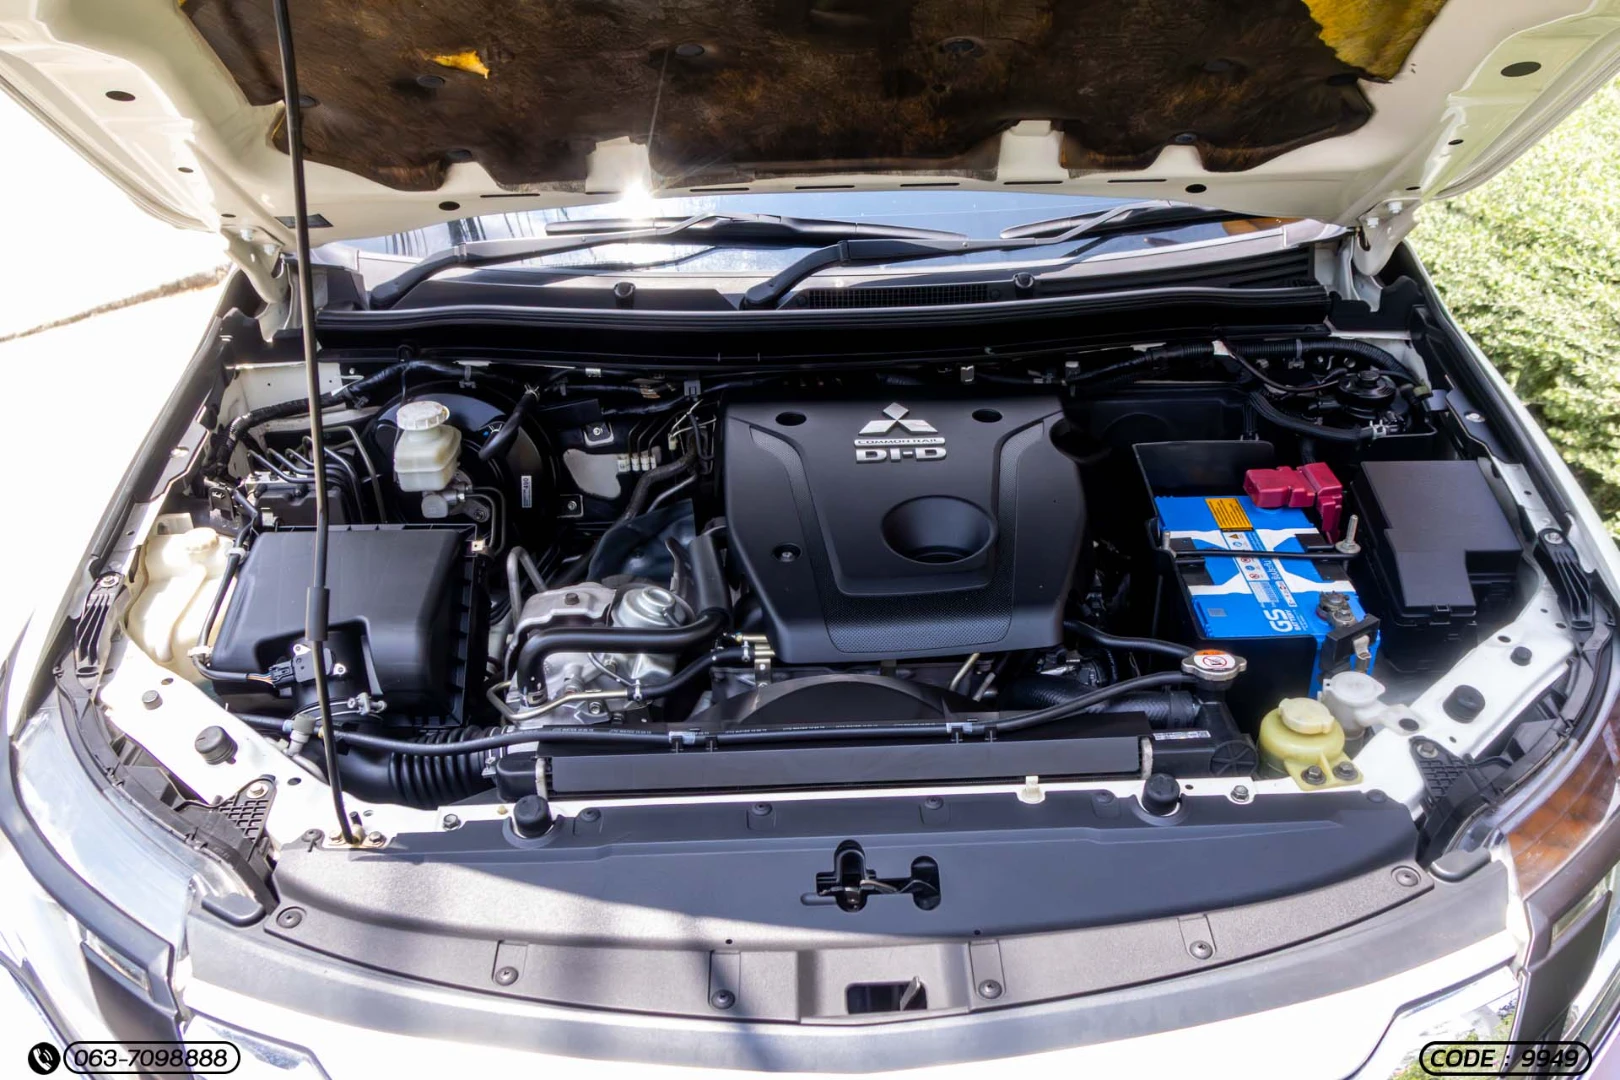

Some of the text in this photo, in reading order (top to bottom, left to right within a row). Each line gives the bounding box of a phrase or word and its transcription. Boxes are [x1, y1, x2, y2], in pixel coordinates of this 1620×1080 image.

[855, 447, 947, 461] DI-D
[1263, 608, 1293, 633] GS
[1284, 609, 1302, 631] BATTERY
